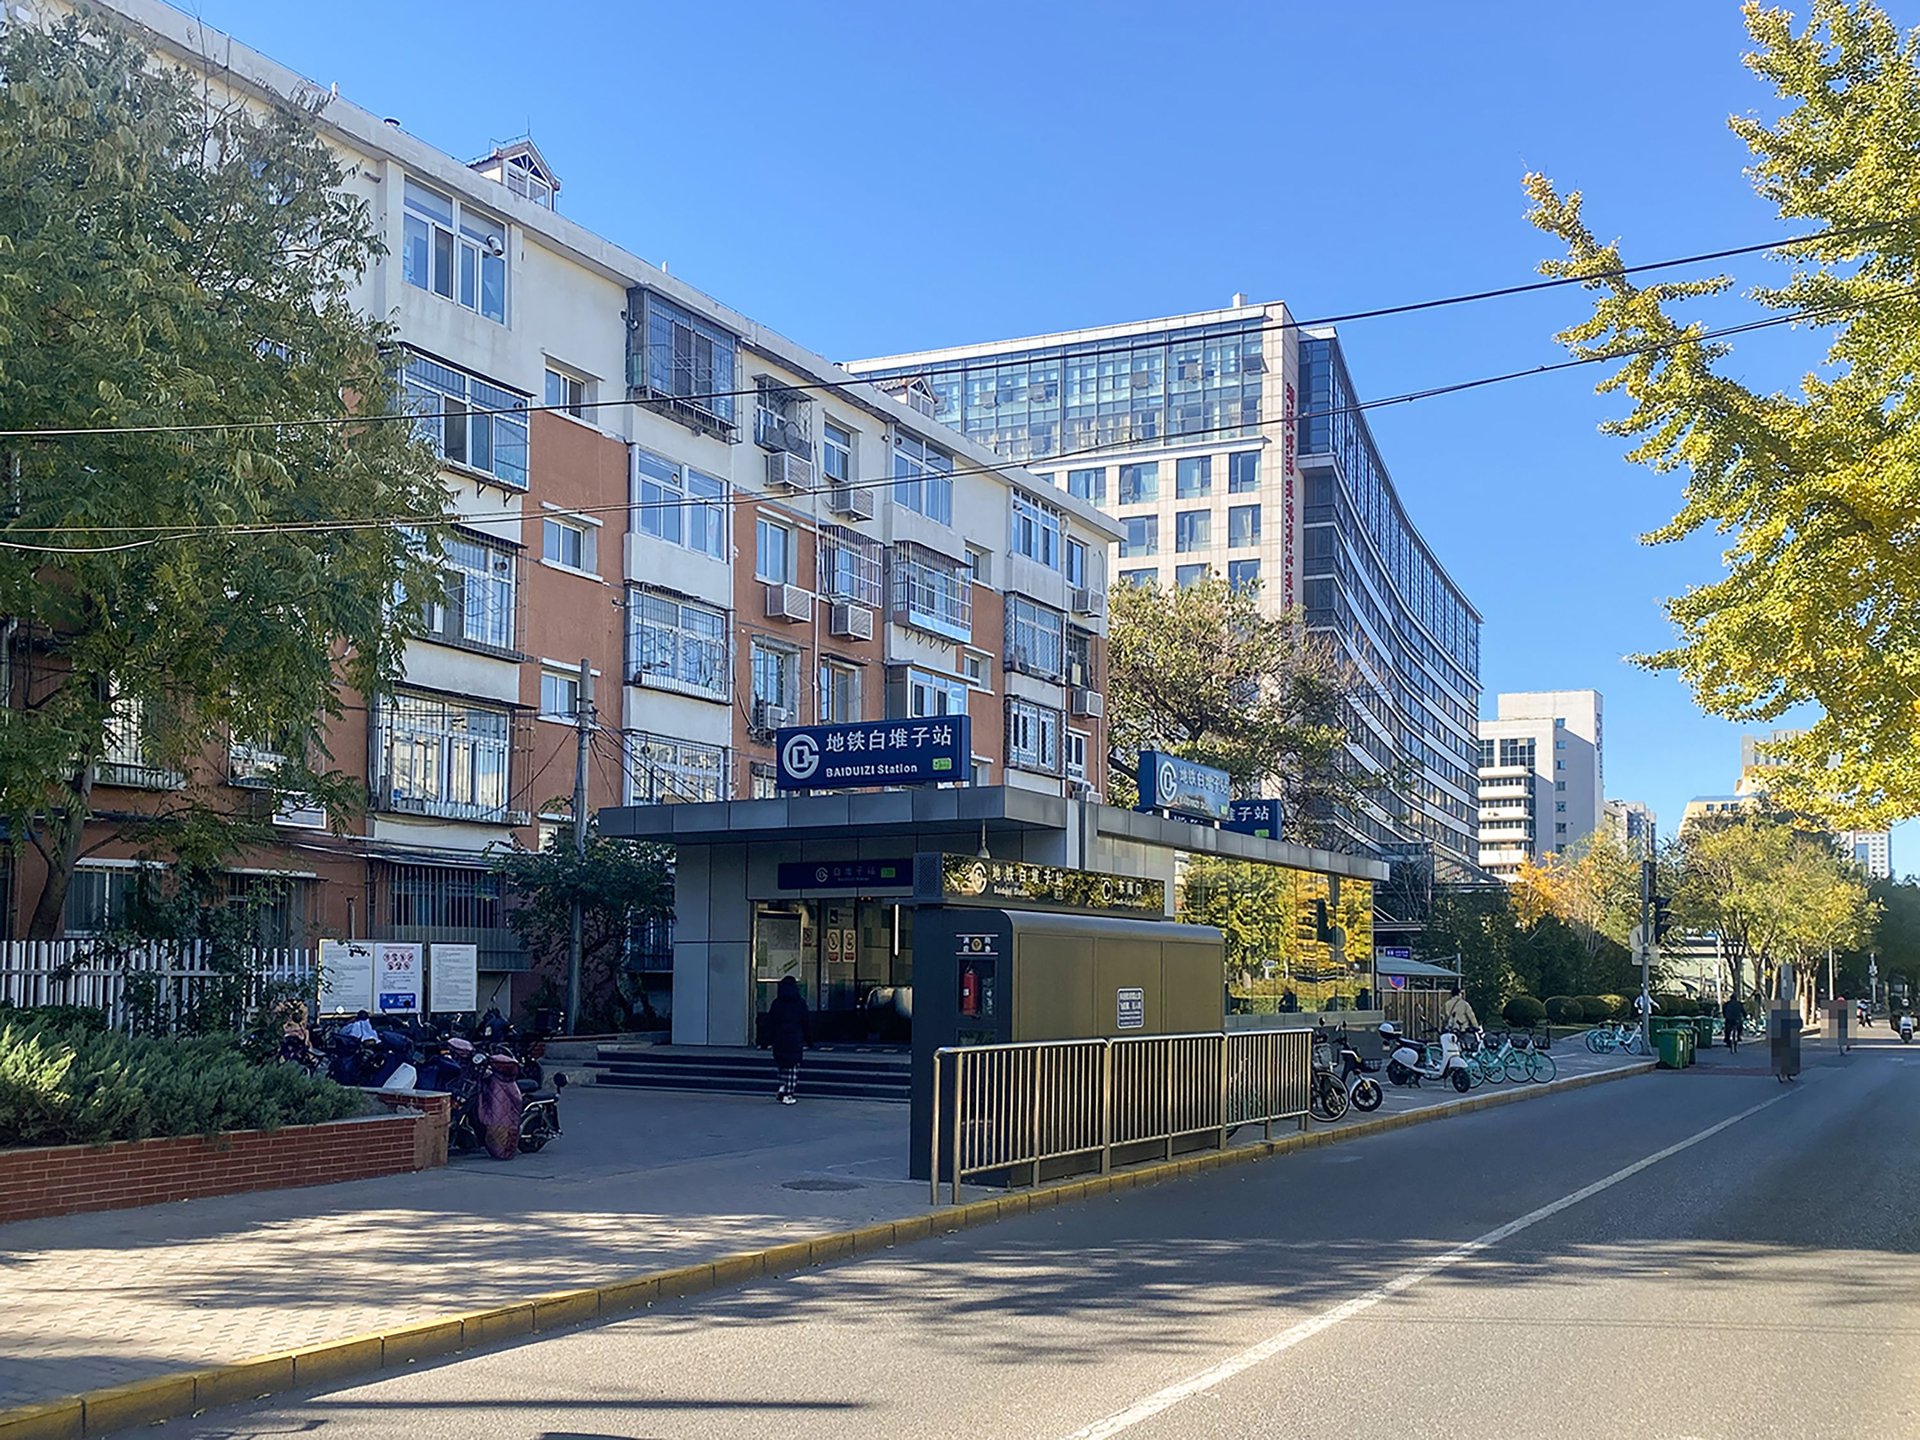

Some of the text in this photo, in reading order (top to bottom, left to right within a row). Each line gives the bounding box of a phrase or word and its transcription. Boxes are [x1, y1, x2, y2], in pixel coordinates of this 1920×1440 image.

[825, 724, 953, 752] 地铁白堆子站
[825, 766, 875, 778] BAIDUIZI
[877, 763, 918, 775] Station
